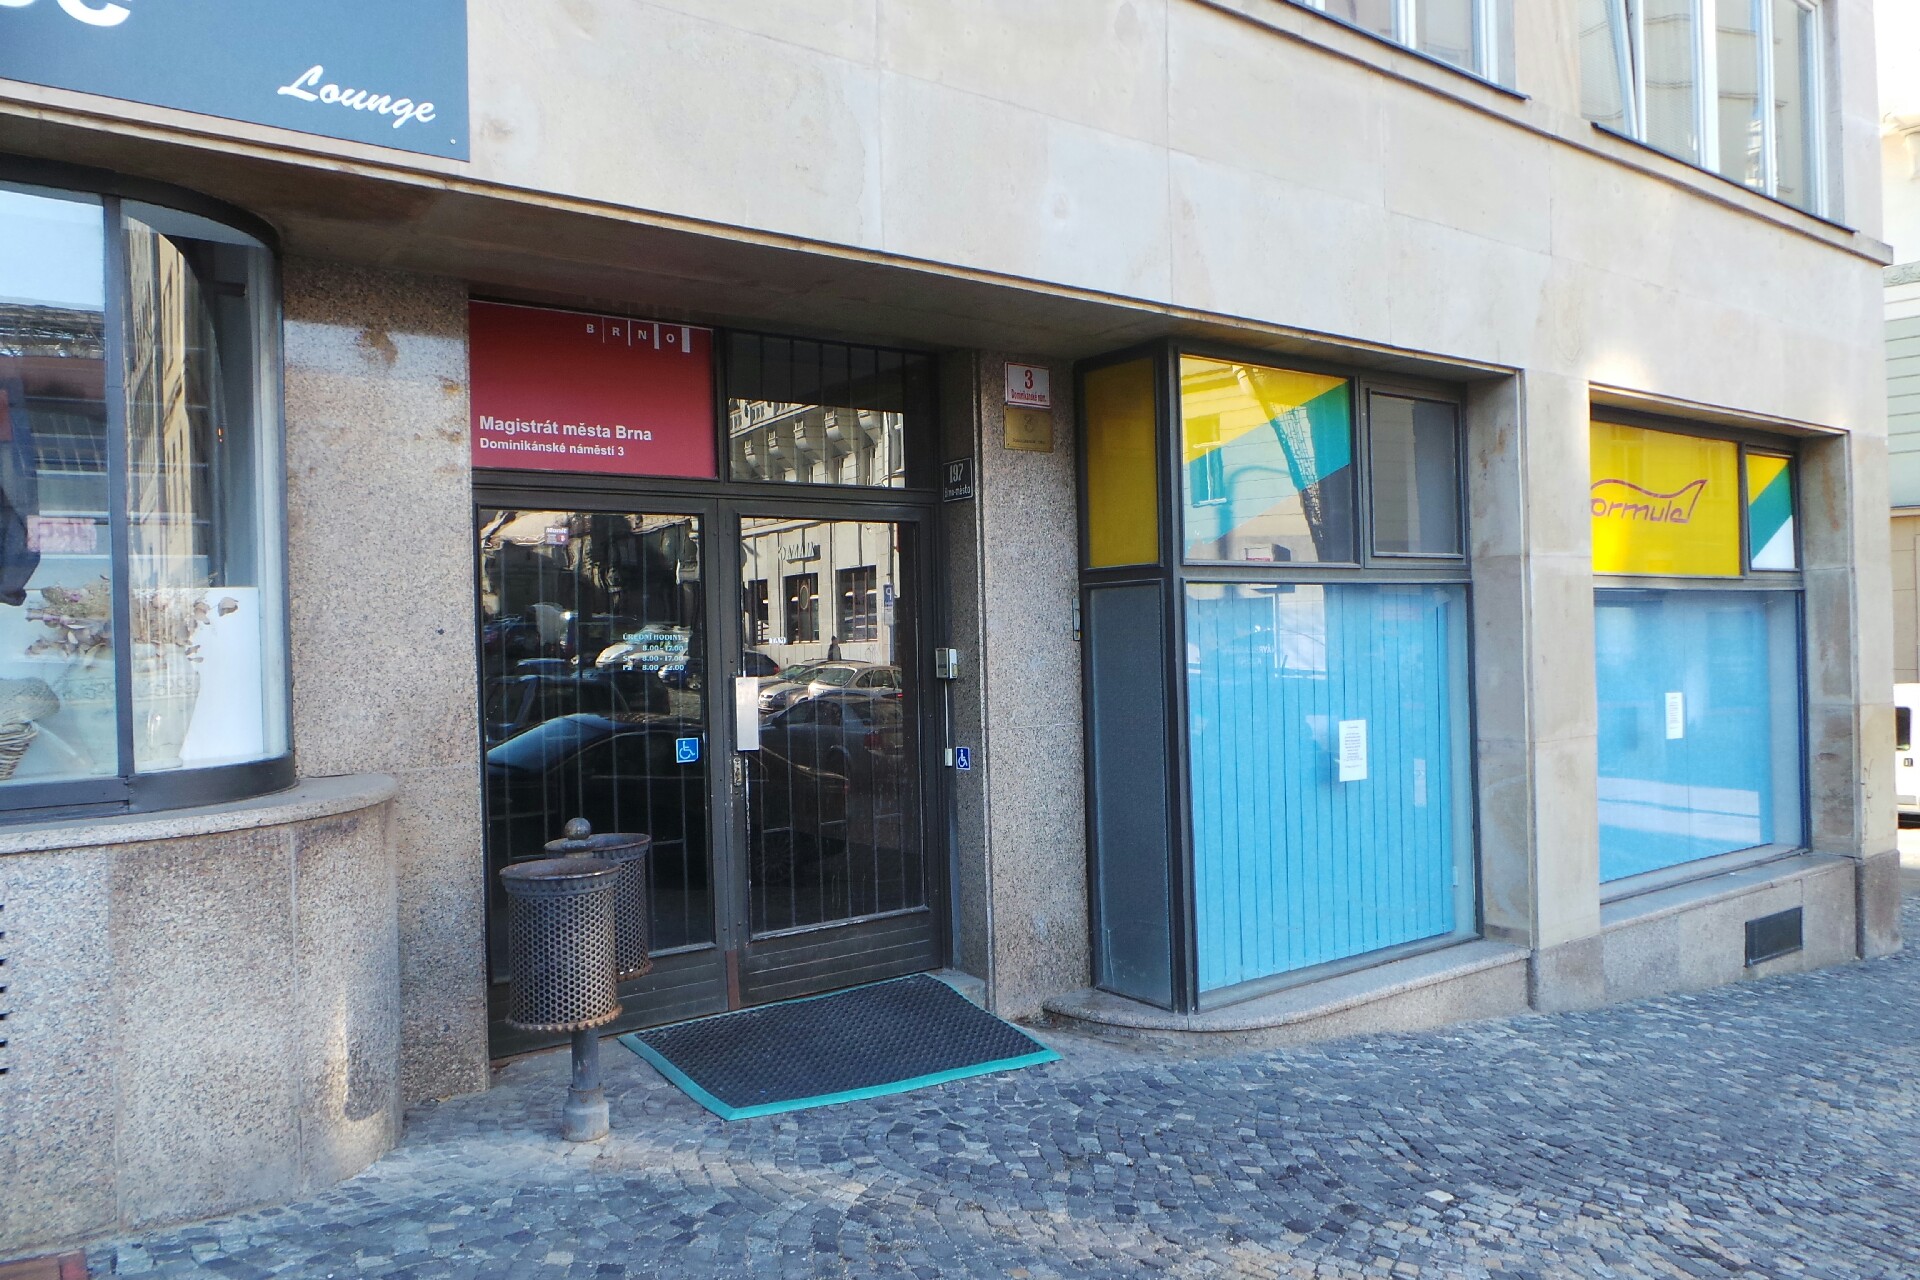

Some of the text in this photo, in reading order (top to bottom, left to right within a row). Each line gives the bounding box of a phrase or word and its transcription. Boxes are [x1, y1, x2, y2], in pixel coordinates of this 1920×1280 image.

[277, 64, 436, 128] Lounge
[1024, 369, 1034, 389] 3
[479, 415, 652, 441] Magistrát města Brna
[479, 438, 624, 456] Dominikánské náměstí 3
[949, 463, 964, 484] 197
[1591, 488, 1702, 523] ormula
